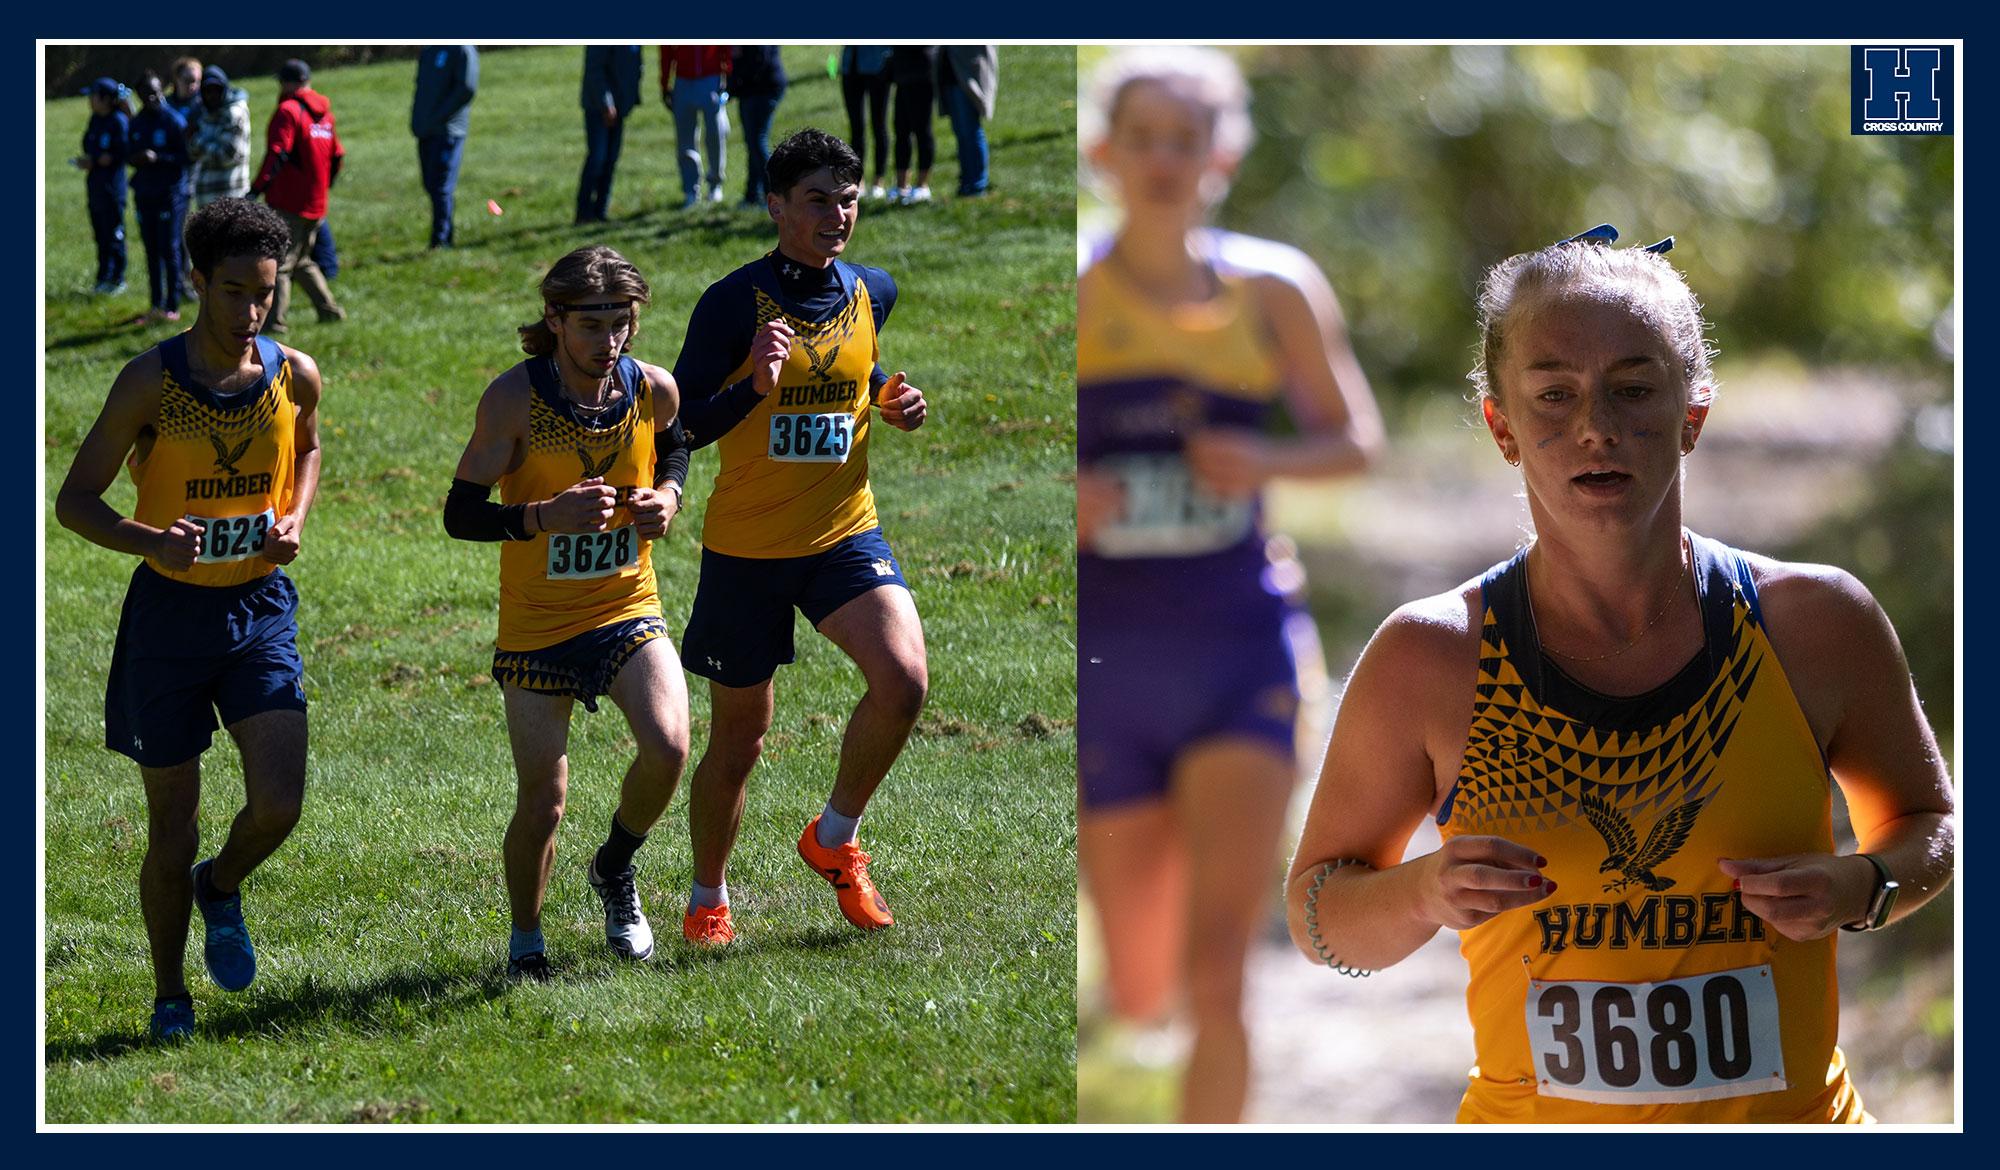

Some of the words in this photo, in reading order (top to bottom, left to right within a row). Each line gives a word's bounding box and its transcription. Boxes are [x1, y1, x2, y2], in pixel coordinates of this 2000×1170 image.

[778, 379, 858, 407] HUMBER
[773, 415, 848, 456] 3625
[185, 472, 273, 502] HUMBER
[552, 527, 630, 574] 3628
[1537, 975, 1753, 1088] 3680
